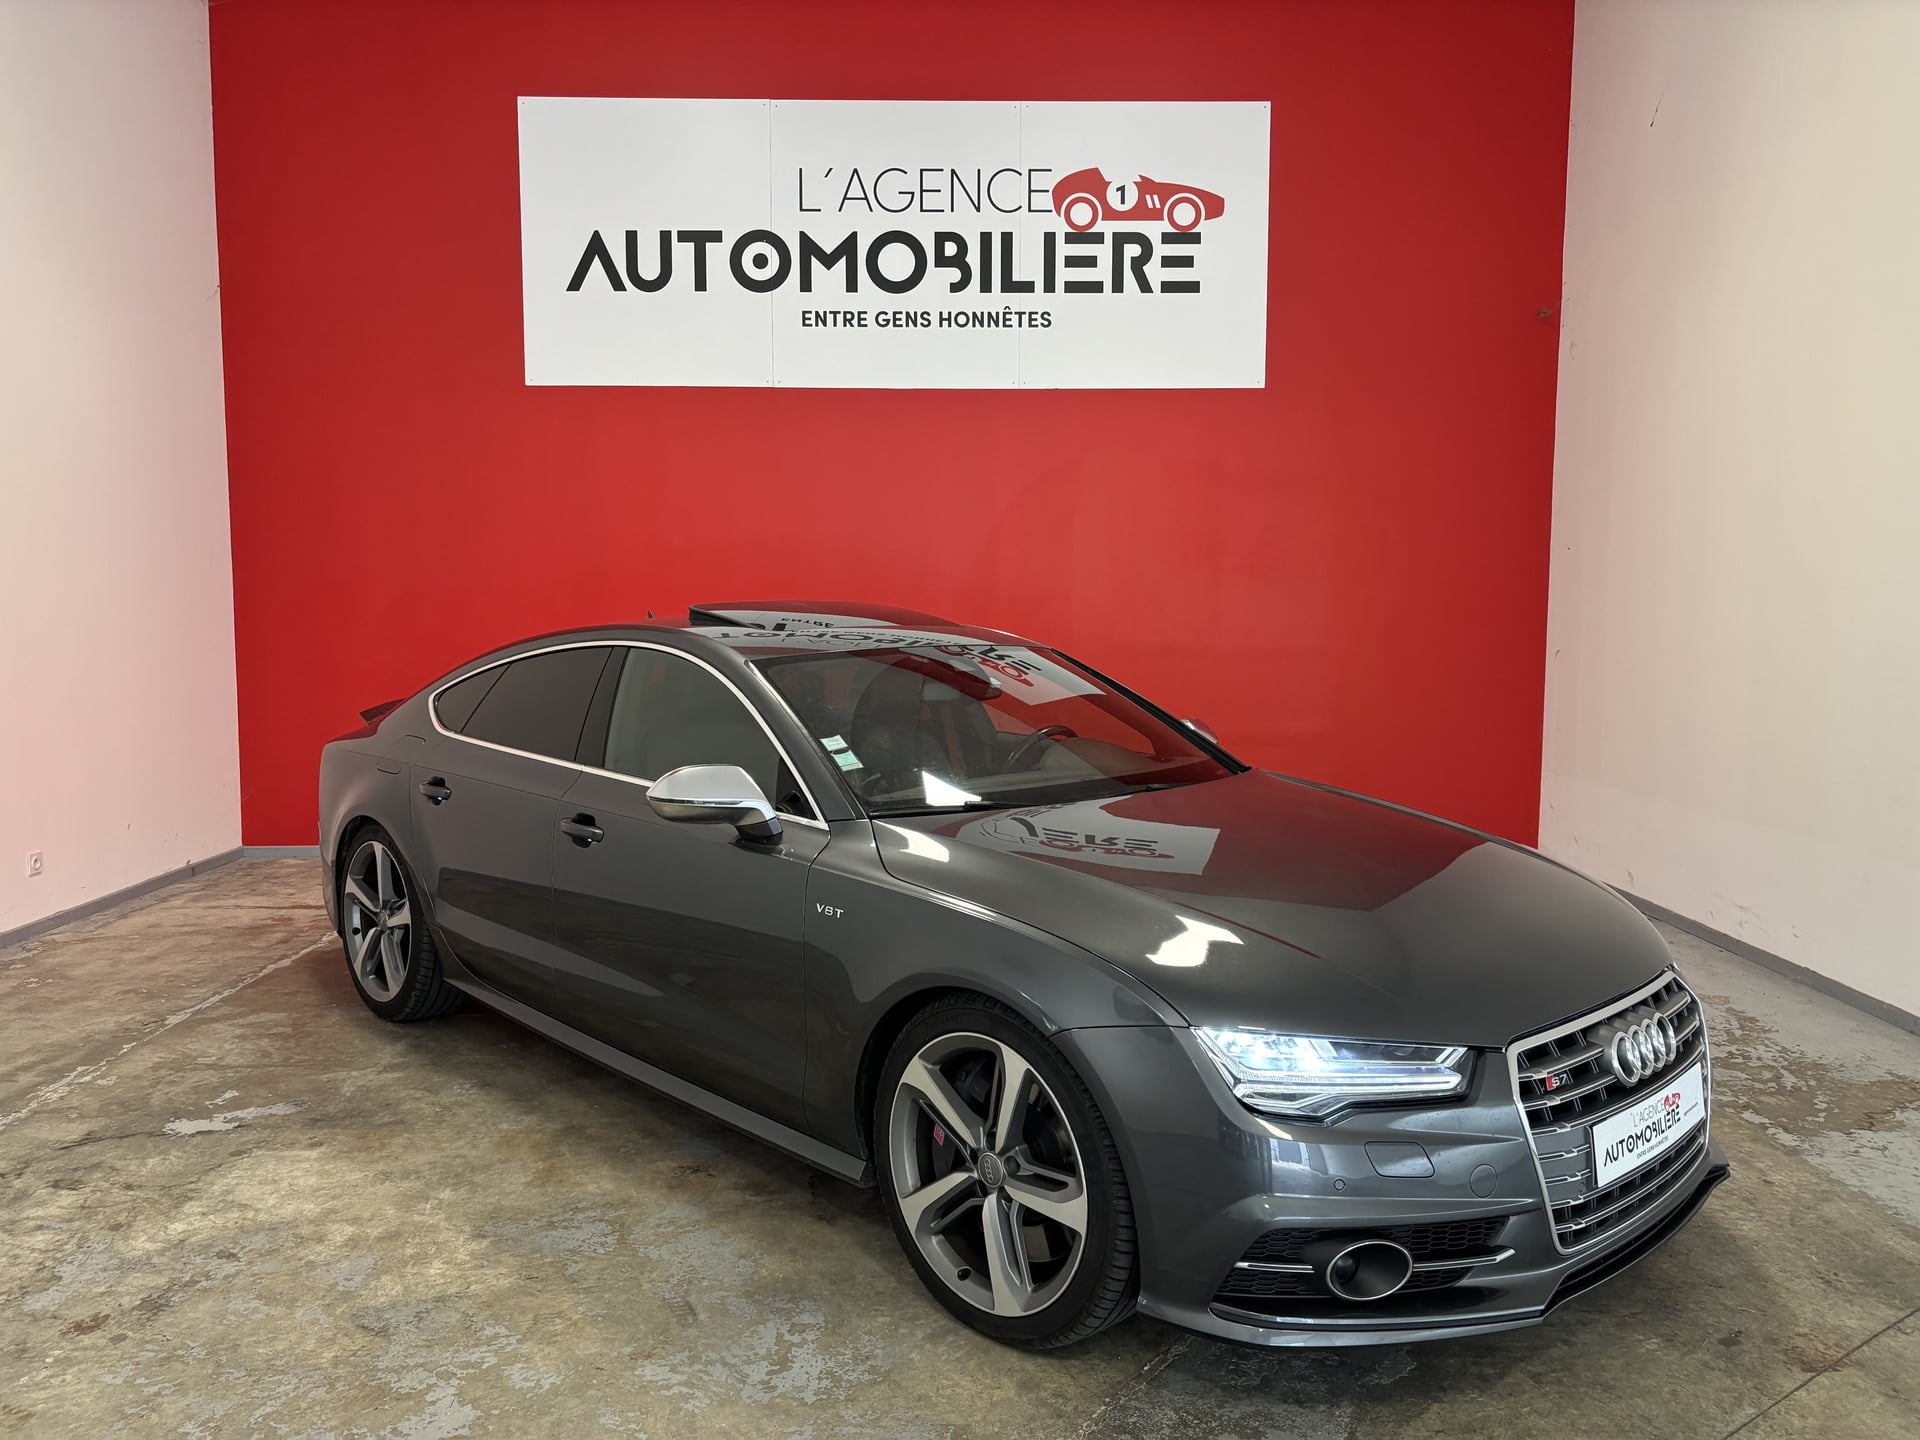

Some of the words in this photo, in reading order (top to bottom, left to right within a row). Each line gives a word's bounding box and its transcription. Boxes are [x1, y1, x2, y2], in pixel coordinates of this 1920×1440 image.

[799, 167, 1053, 213] L'AGENCE
[1115, 184, 1126, 205] 1
[801, 310, 868, 328] ENTRE
[875, 310, 932, 328] GENS
[938, 306, 1053, 328] HONNÊTES
[816, 903, 844, 919] V8T
[1551, 1073, 1567, 1087] S7
[1632, 1097, 1665, 1127] L'AGENCE
